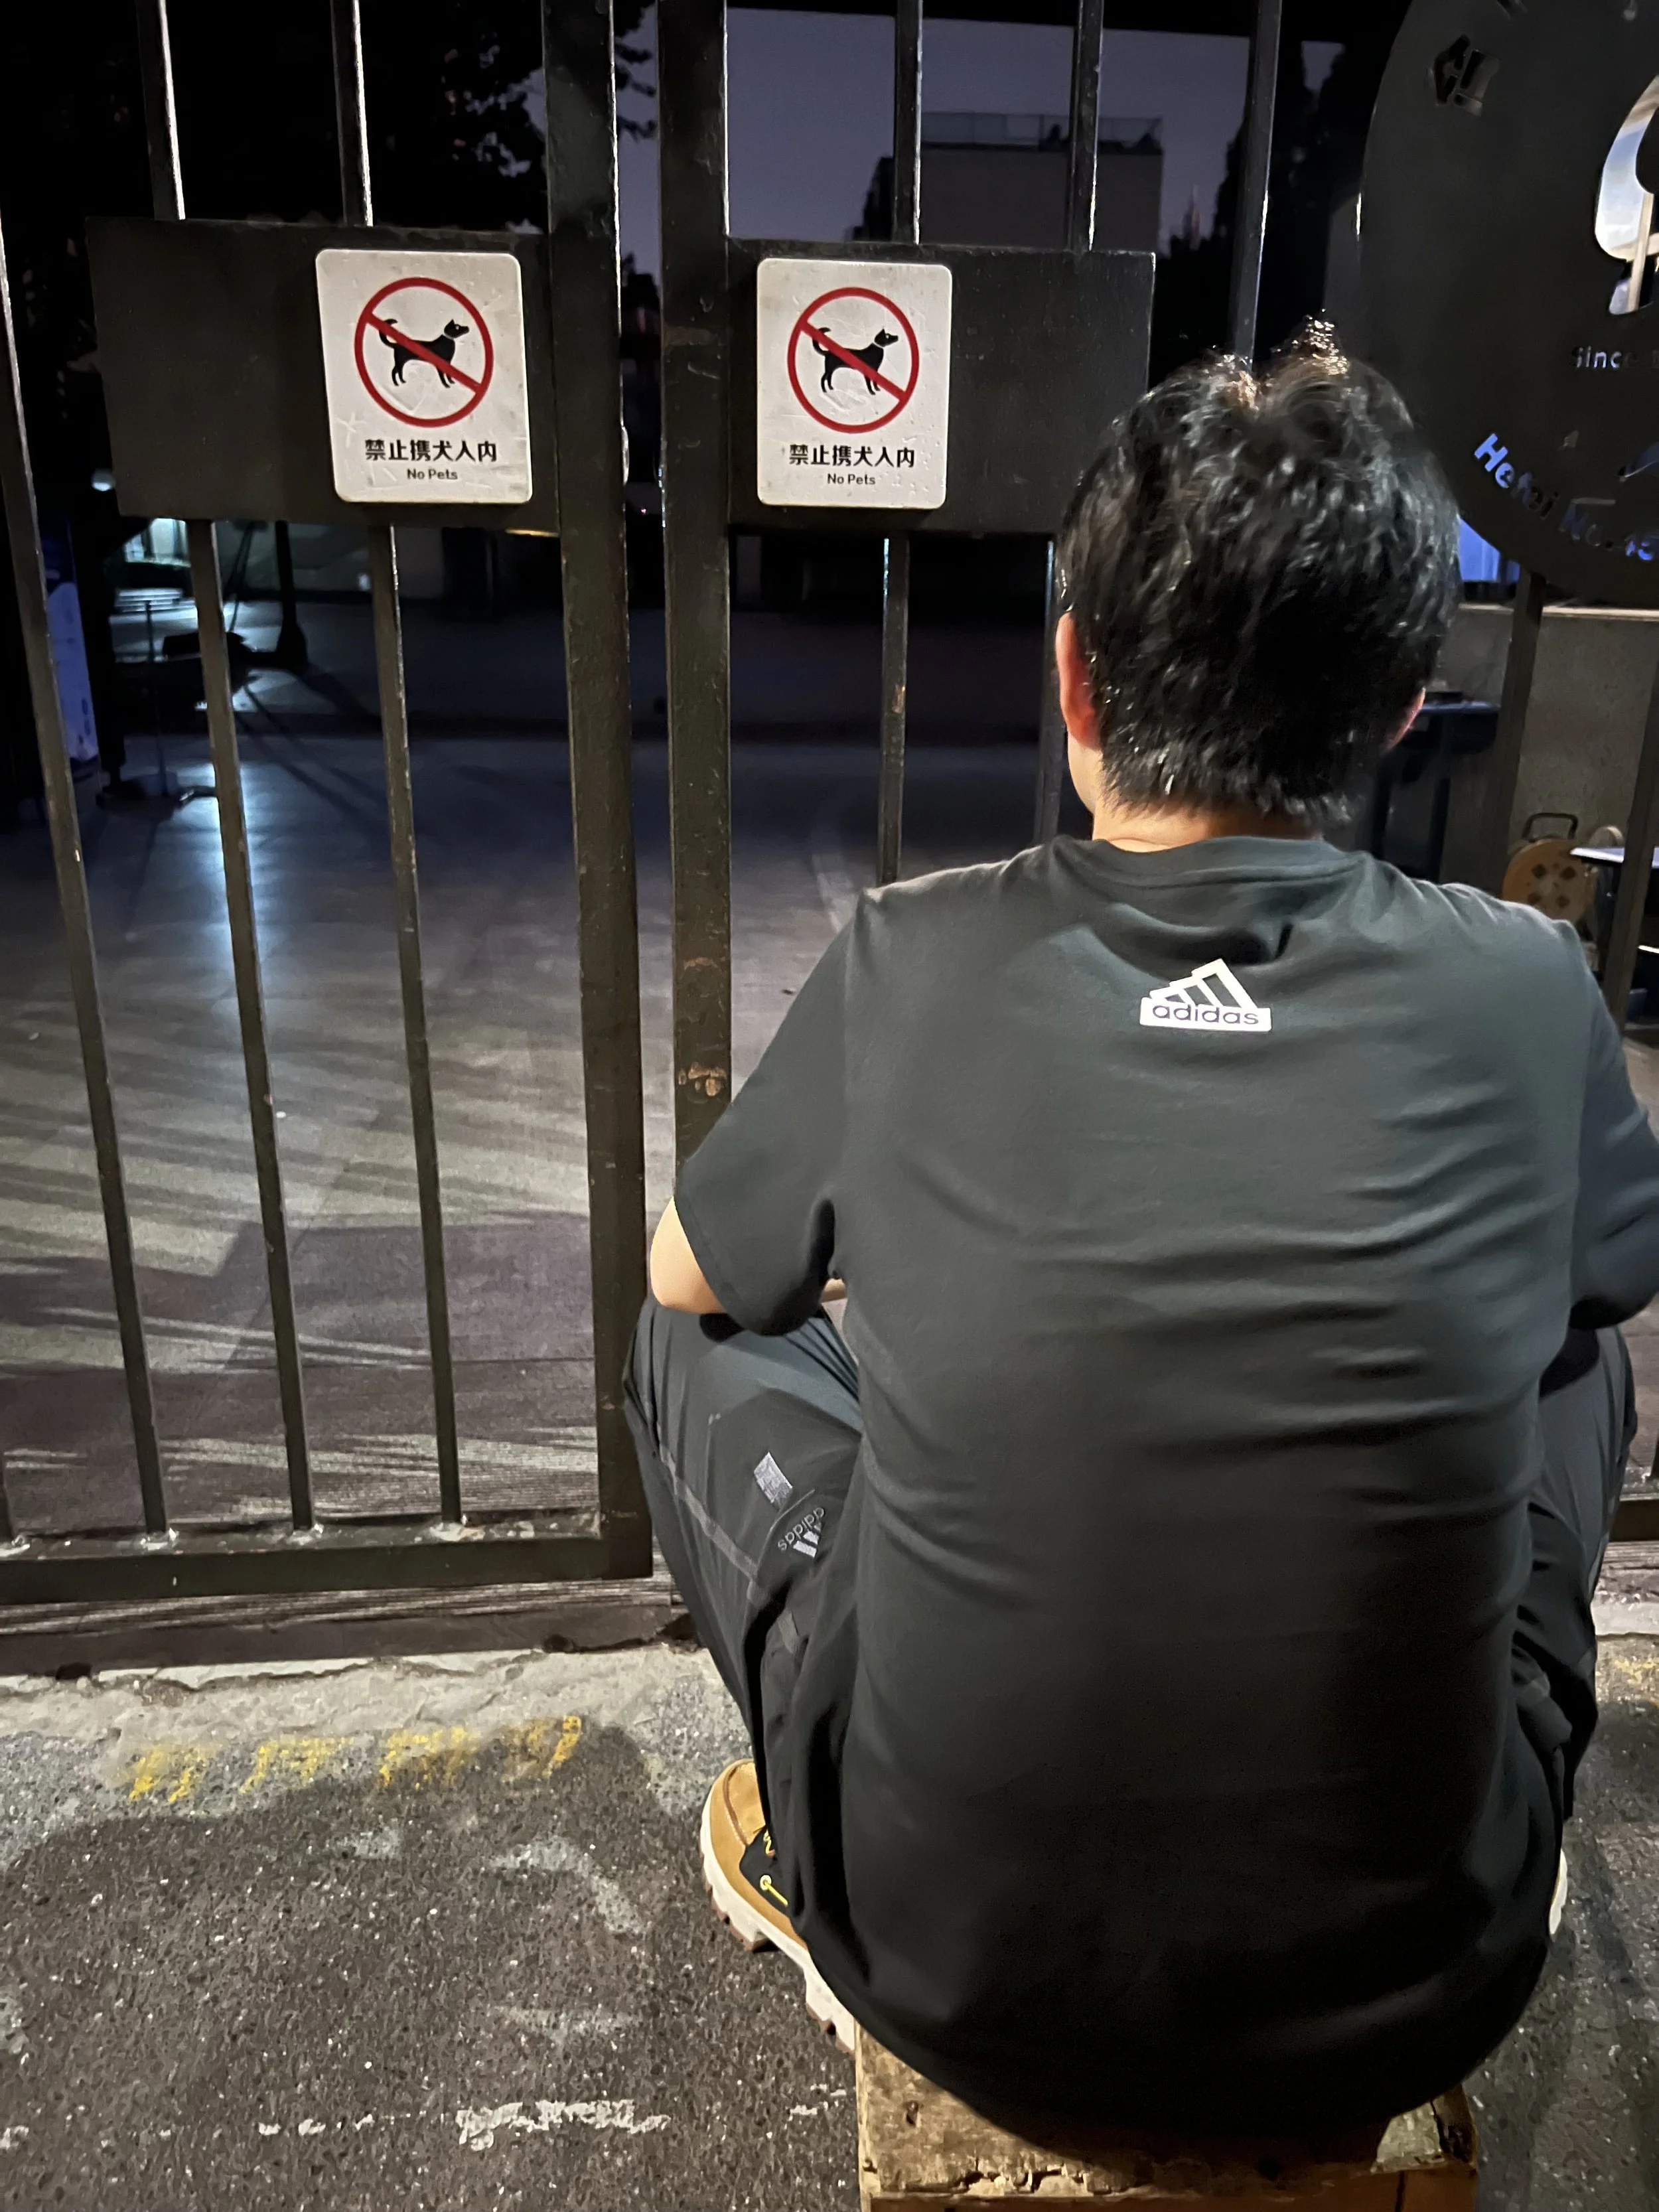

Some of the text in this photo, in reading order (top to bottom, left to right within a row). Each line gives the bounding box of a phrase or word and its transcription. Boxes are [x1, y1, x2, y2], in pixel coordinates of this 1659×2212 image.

[364, 439, 497, 463] 禁止携犬入内
[789, 444, 915, 468] 禁止携犬入内
[407, 469, 458, 480] No Pets
[828, 473, 876, 485] No Pets
[1152, 1004, 1260, 1025] adidas
[777, 1507, 826, 1551] adidas
